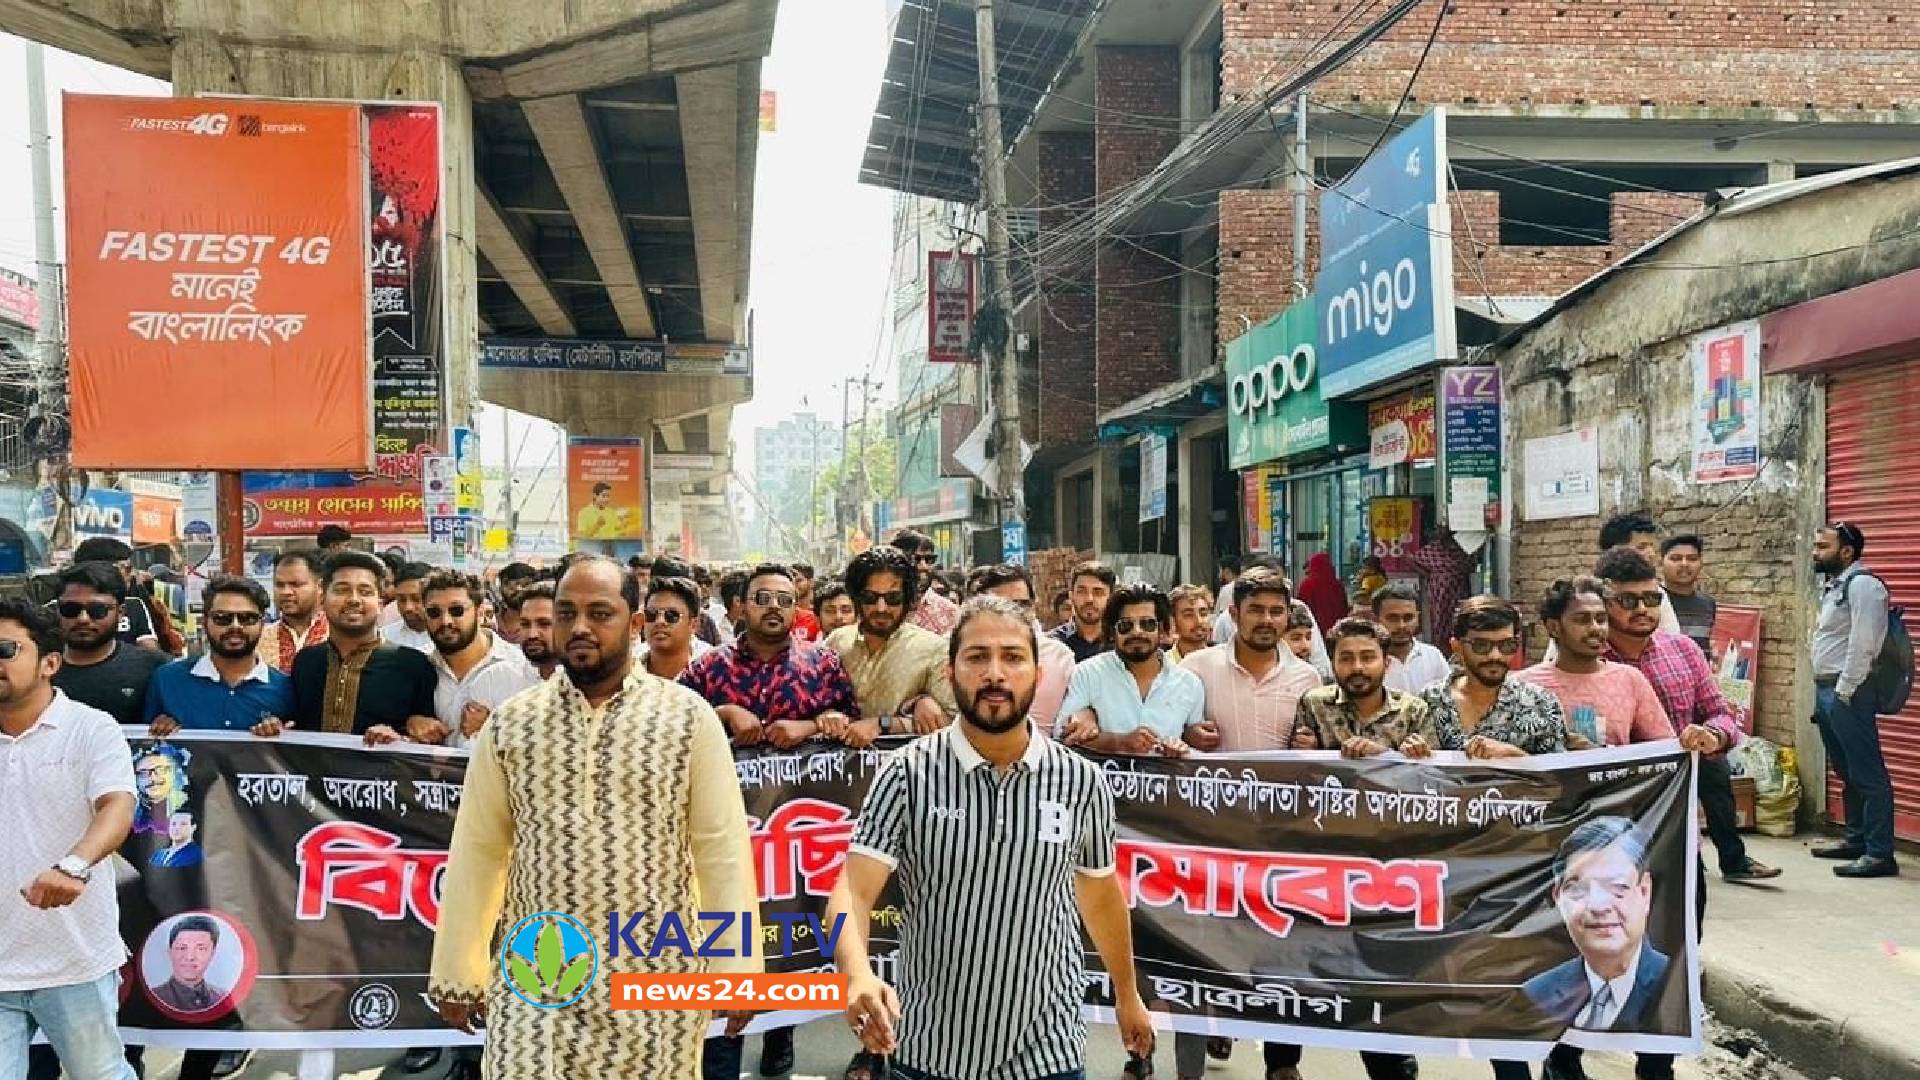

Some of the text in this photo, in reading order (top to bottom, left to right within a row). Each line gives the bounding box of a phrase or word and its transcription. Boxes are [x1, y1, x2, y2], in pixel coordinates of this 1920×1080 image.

[130, 113, 230, 135] FASTEST 4G
[100, 231, 331, 265] FASTEST 4G
[172, 267, 261, 301] মানেই
[1327, 258, 1416, 344] migo
[128, 305, 307, 346] বাংলালিংক
[1231, 343, 1315, 425] oppo
[1452, 372, 1495, 396] YZ
[317, 495, 373, 516] হোসেন
[927, 806, 966, 820] POLO
[1102, 759, 1171, 807] তিষ্ঠানে
[1305, 774, 1361, 831] সৃষ্টির
[1364, 782, 1461, 828] অপচেষ্টার
[1038, 800, 1069, 843] B
[1148, 974, 1350, 1024] ছাত্রলীগ
